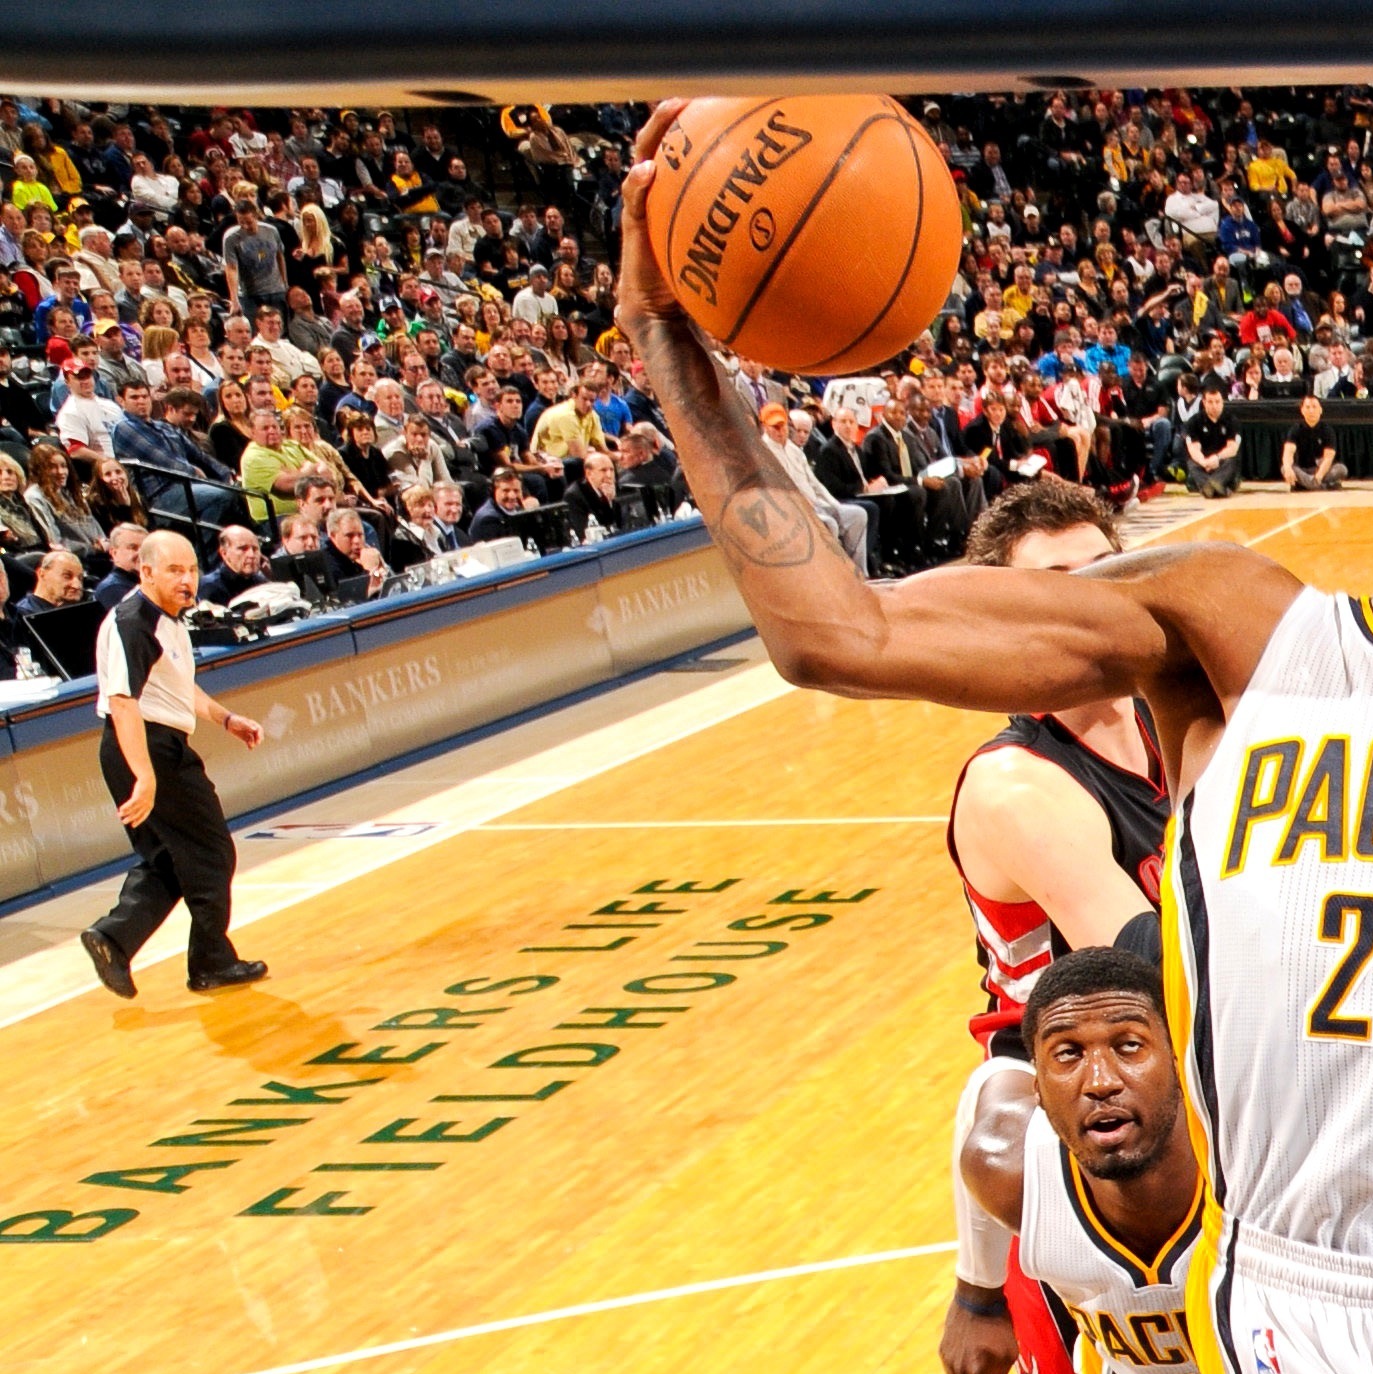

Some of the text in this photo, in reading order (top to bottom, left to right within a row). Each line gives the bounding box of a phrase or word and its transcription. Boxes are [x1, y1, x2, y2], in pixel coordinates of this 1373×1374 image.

[679, 110, 813, 307] SPALDING
[304, 656, 442, 725] BANKERS
[618, 571, 711, 624] BANKERS
[0, 878, 744, 1244] BANKERS LIFE
[236, 887, 882, 1217] FIELDHOUSE
